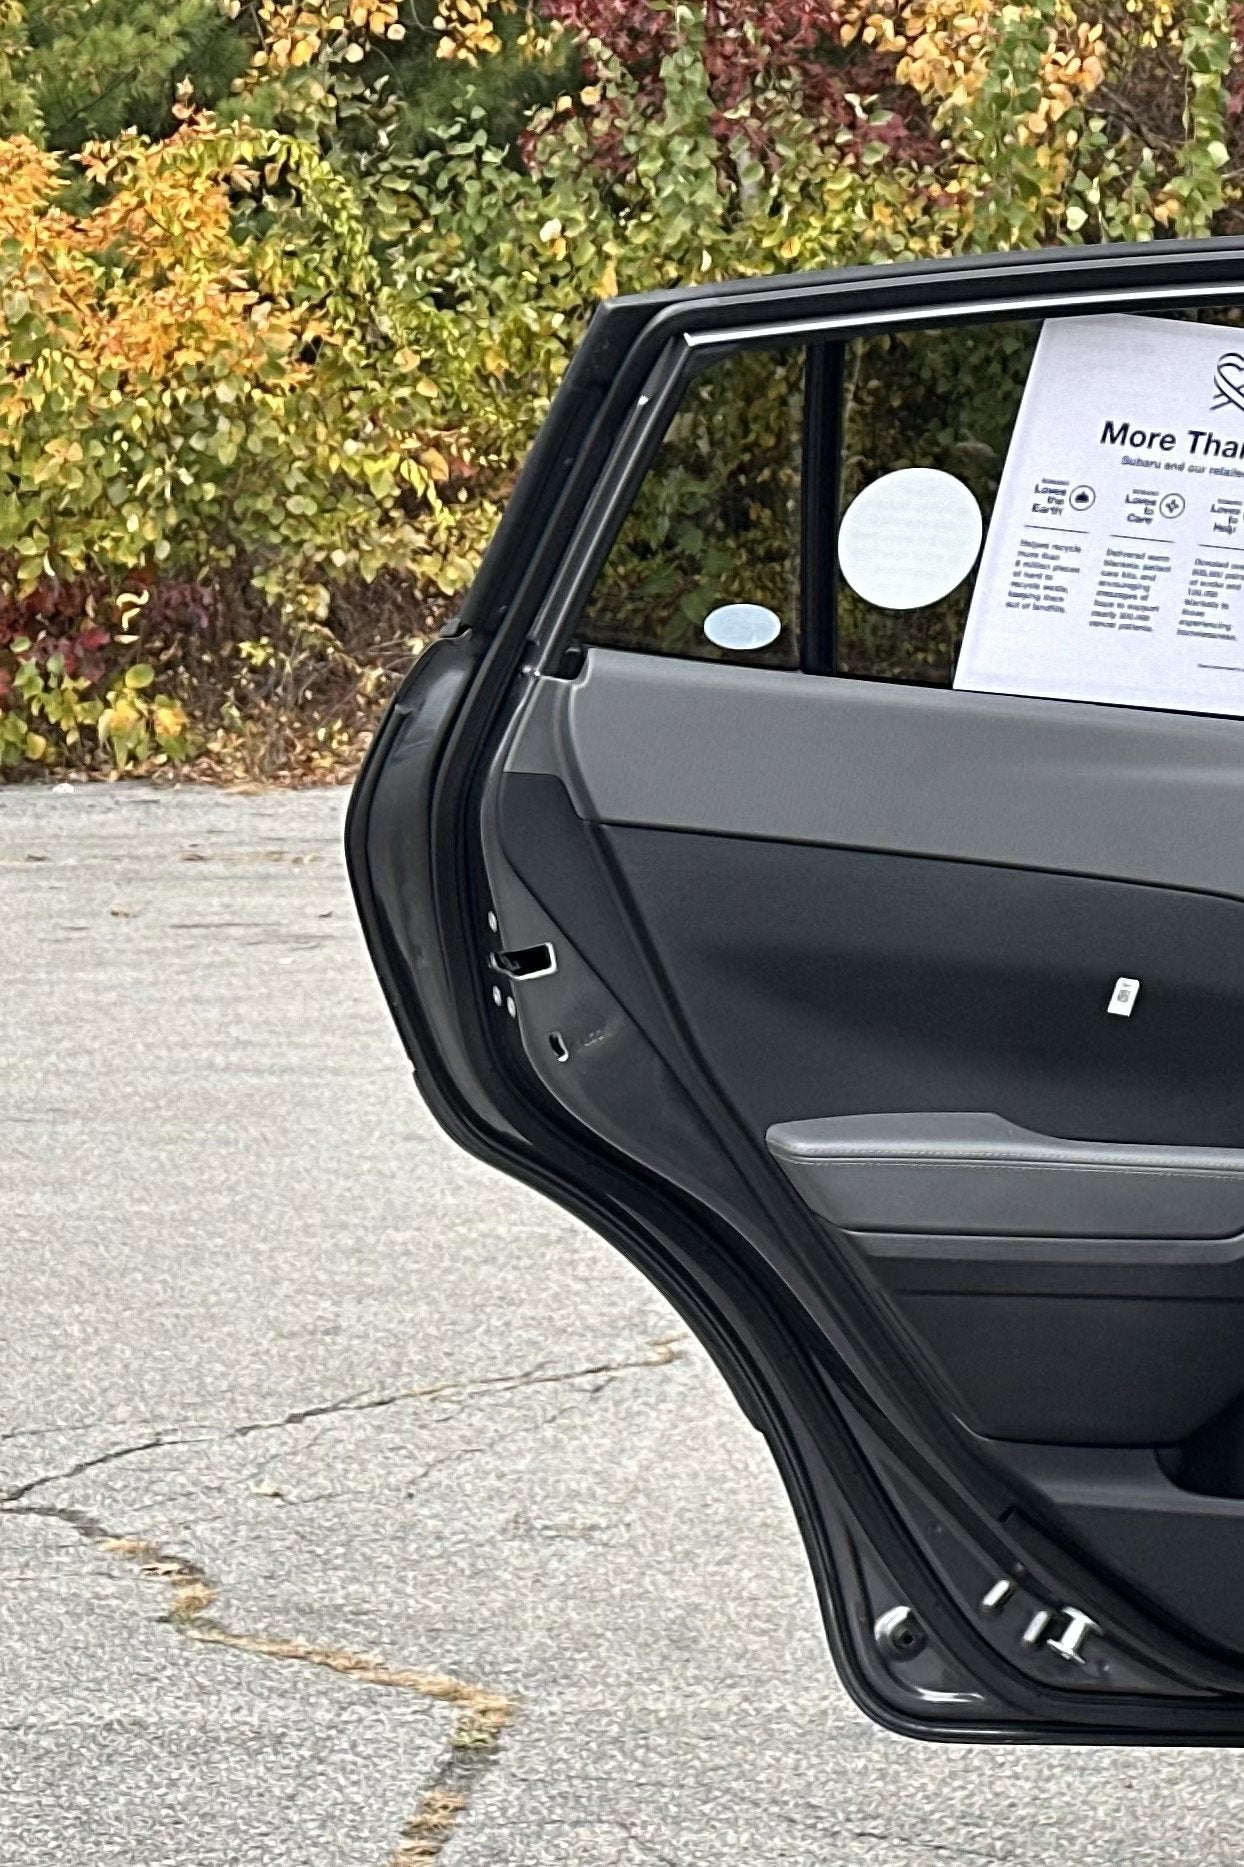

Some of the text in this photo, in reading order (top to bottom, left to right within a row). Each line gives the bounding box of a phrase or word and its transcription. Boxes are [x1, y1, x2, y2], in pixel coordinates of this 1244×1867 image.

[1099, 421, 1179, 451] More
[1120, 455, 1161, 468] Subaru
[1164, 460, 1185, 470] and
